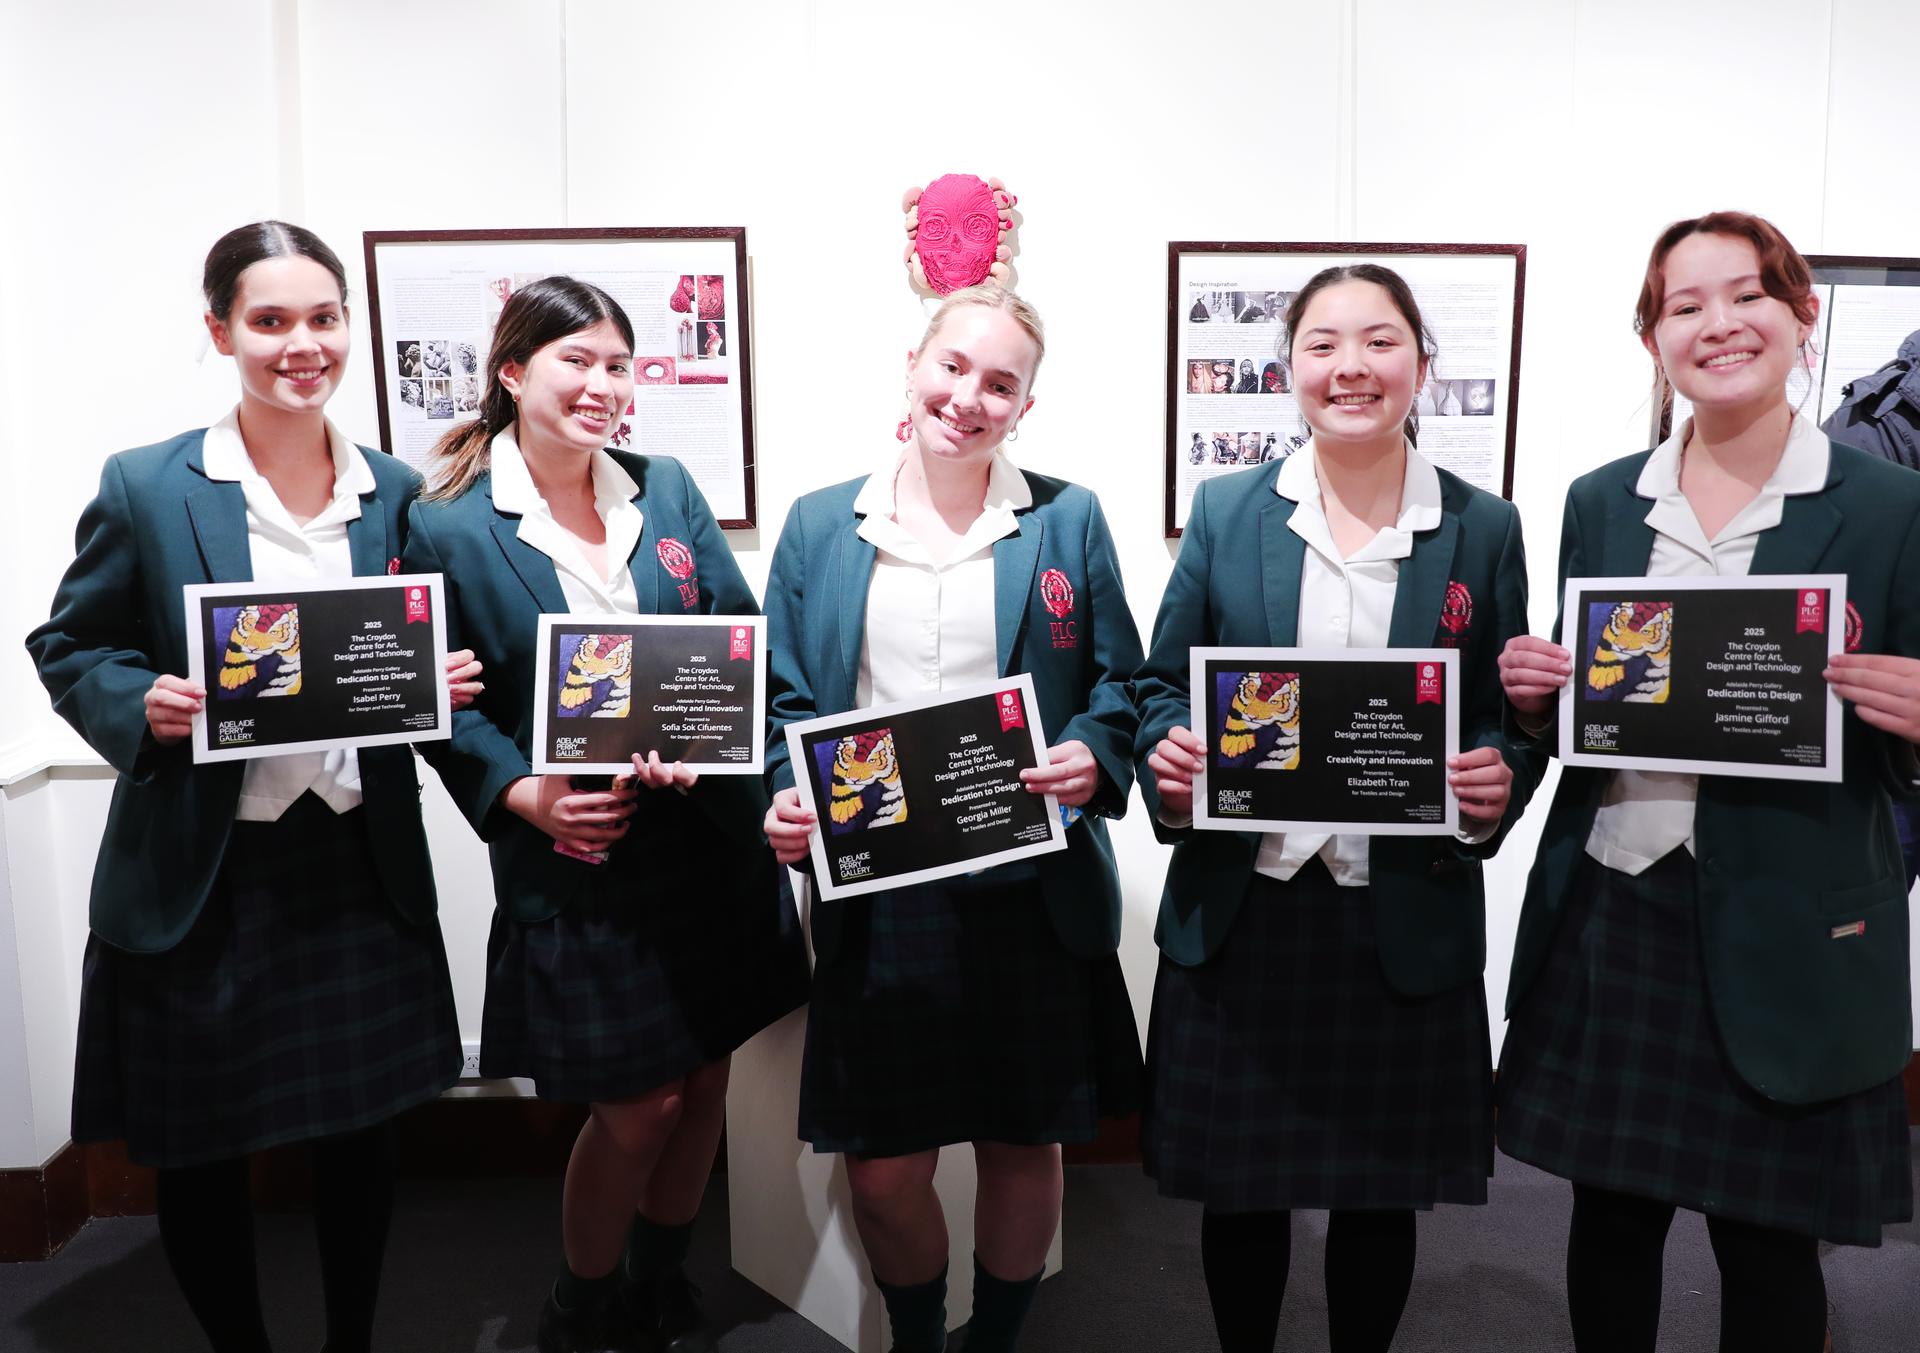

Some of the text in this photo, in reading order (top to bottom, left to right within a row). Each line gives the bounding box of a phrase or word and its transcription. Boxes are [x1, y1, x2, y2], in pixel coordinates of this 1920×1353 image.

[677, 578, 699, 601] PLC
[409, 601, 424, 609] PLC
[1802, 607, 1819, 615] PLC
[364, 621, 382, 629] 2025
[1049, 621, 1077, 639] PLC
[1744, 628, 1765, 636] 2025
[366, 633, 396, 642] Croydon
[1728, 642, 1780, 652] The Croydon
[334, 649, 415, 661] Design and Technology
[1724, 652, 1782, 662] Centre for Art,
[691, 667, 718, 675] Croydon
[1707, 662, 1802, 674] Design and Technology
[337, 675, 379, 684] Dedication
[390, 672, 416, 680] Design
[1421, 679, 1437, 687] PLC
[661, 683, 683, 691] Design
[698, 684, 735, 692] Technology
[353, 694, 377, 703] Isabel
[1707, 689, 1802, 701] Dedication to Design
[653, 705, 688, 713] Creativity
[1002, 705, 1018, 716] PLC
[1353, 712, 1403, 722] The Croydon
[1715, 713, 1789, 724] Jasmine Gifford
[219, 719, 254, 729] ADELAIDE
[1584, 724, 1619, 733] ADELAIDE
[219, 727, 244, 735] PERRY
[1335, 731, 1423, 741] Design and Technology
[219, 733, 252, 742] GALLERY
[960, 734, 977, 744] 2025
[1584, 739, 1616, 747] GALLERY
[964, 745, 993, 756] Croydon
[948, 759, 972, 769] Centre
[985, 753, 998, 761] Art,
[1327, 756, 1433, 765] Creativity and Innovation
[935, 759, 1015, 782] Design and Technology
[1348, 778, 1409, 787] Elizabeth Tran
[941, 791, 983, 806] Dedication
[994, 782, 1020, 793] Design
[1218, 790, 1252, 798] ADELAIDE
[969, 801, 991, 811] Presented
[957, 806, 1012, 824] Georgia Miller
[839, 852, 870, 865] ADELAIDE
[840, 860, 861, 871] PERRY
[841, 866, 870, 878] GALLERY
